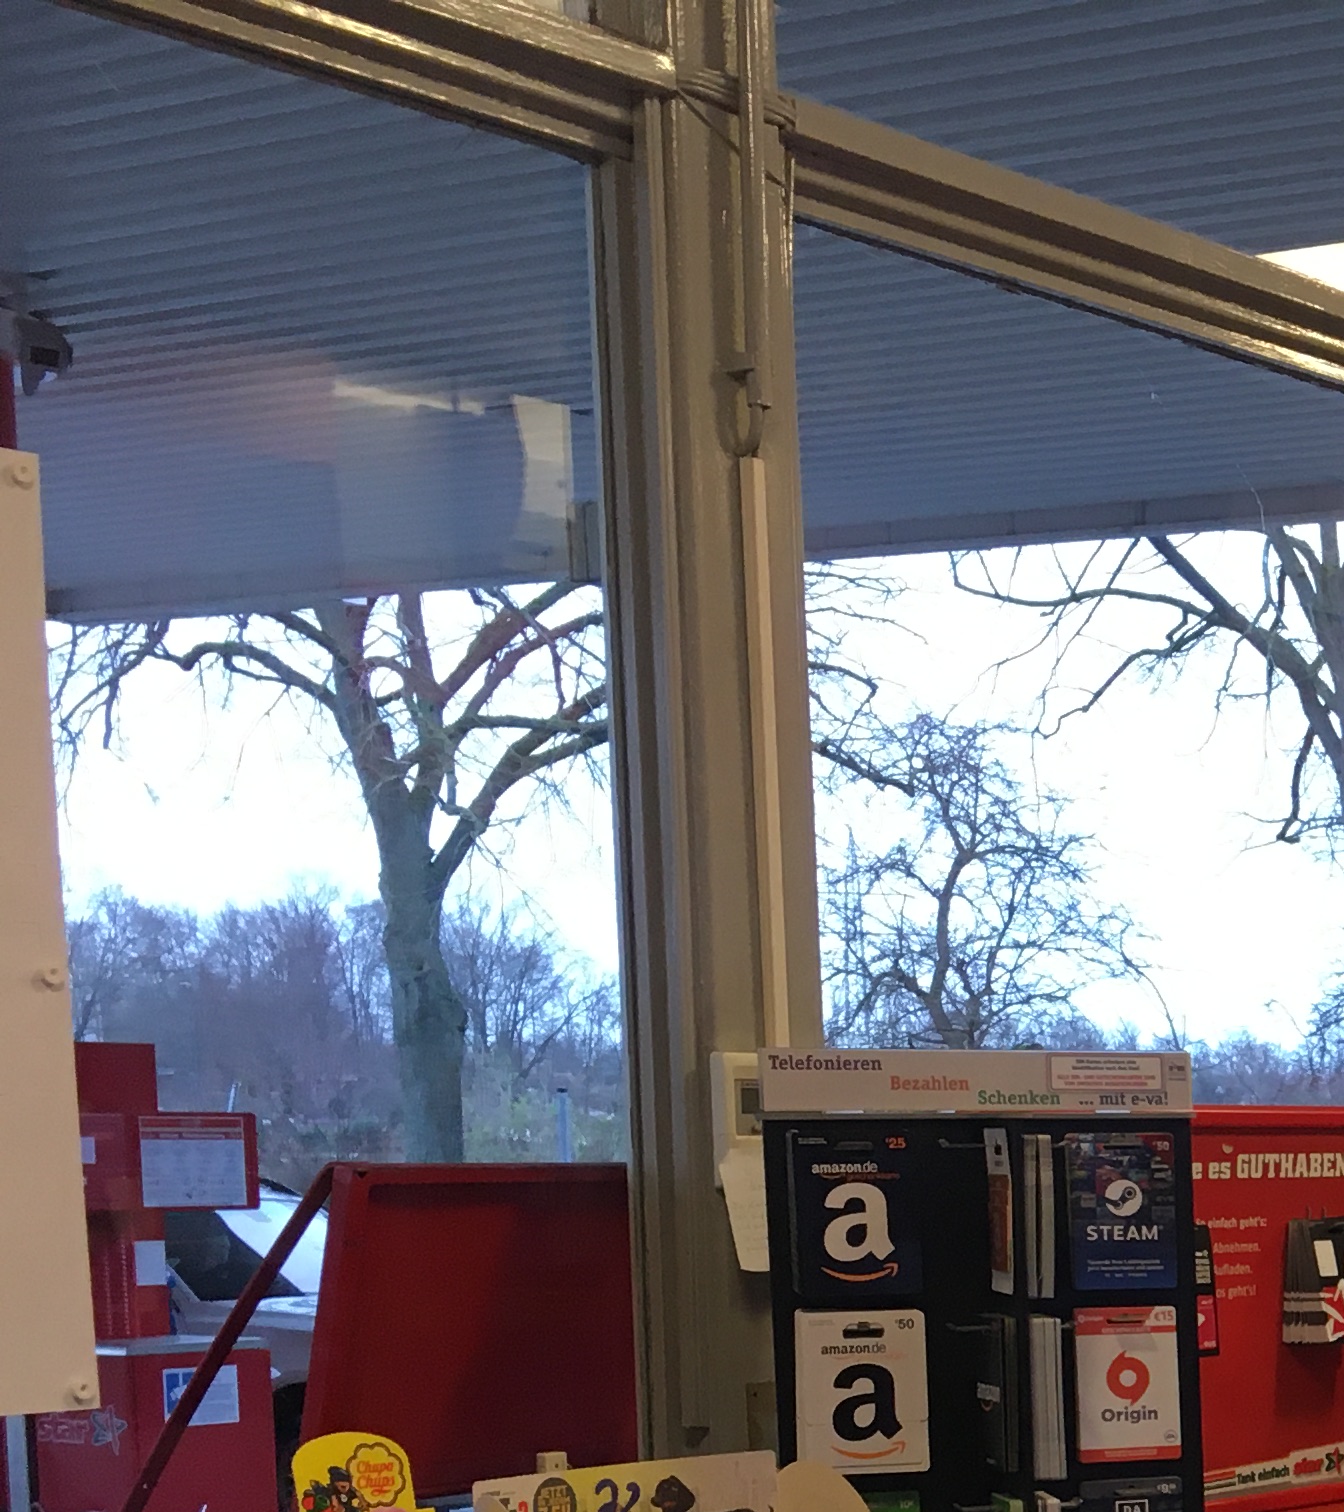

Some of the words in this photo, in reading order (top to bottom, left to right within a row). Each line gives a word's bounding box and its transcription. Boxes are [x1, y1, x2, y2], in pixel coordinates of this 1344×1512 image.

[768, 1055, 883, 1071] Telefonieren
[890, 1076, 969, 1091] Bezahlen
[978, 1090, 1061, 1106] Schenken
[1099, 1091, 1125, 1106] mit
[1131, 1091, 1169, 1106] e-va!
[811, 1161, 878, 1175] amazon.de
[1208, 1162, 1231, 1179] es
[822, 1182, 895, 1261] a
[1208, 1217, 1237, 1229] einfach
[1086, 1225, 1159, 1241] STEAM
[1213, 1242, 1261, 1253] Abnehmen.
[1154, 1311, 1174, 1322] €15
[821, 1343, 887, 1356] amazon.de
[832, 1363, 903, 1442] a
[1101, 1407, 1159, 1423] Origin
[357, 1460, 393, 1474] Chupa
[1237, 1472, 1255, 1485] Tank
[1258, 1464, 1289, 1480] einfach
[357, 1474, 395, 1489] Chups
